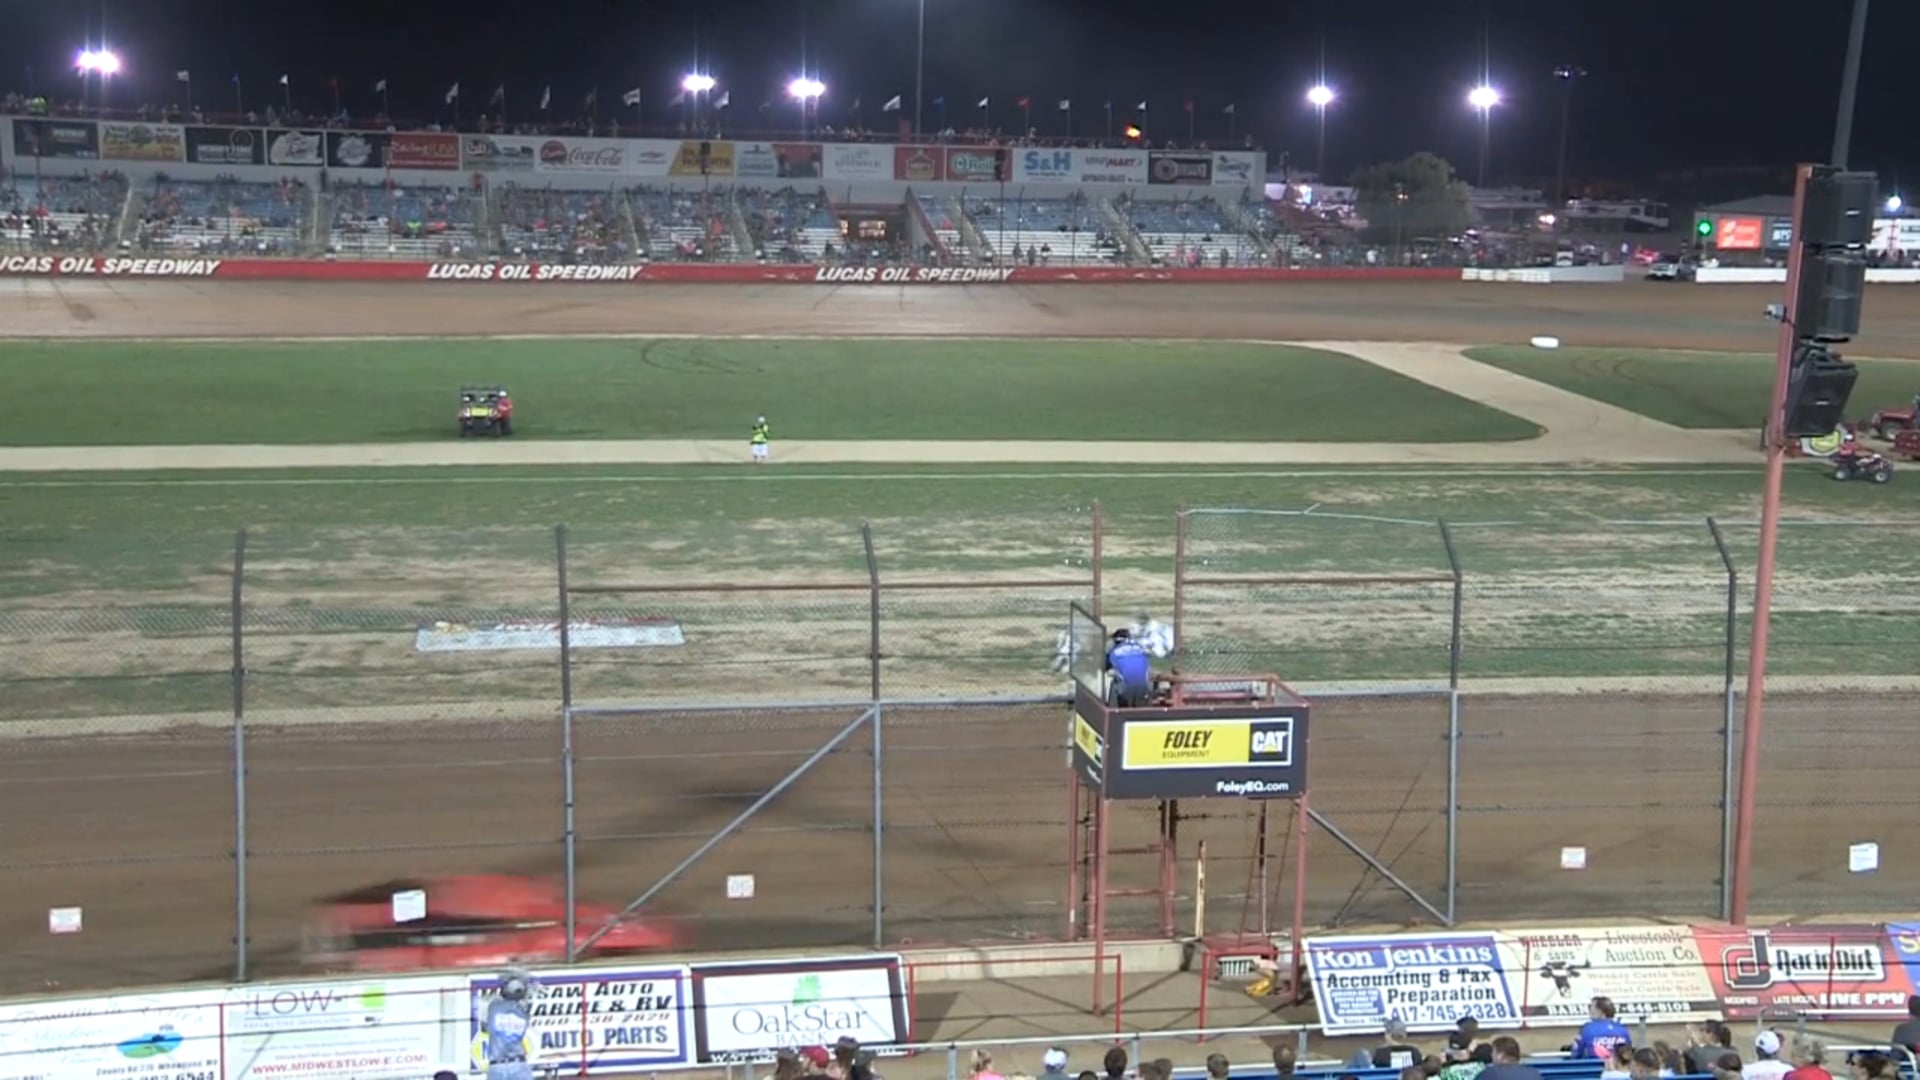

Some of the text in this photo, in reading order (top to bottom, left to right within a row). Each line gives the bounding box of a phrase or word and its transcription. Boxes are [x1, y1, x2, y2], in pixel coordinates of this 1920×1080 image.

[1025, 151, 1071, 171] S&H
[59, 257, 97, 273] OIL
[102, 258, 220, 276] SPEEDWAY
[427, 264, 642, 280] LUCAS OIL SPEEDWAY
[815, 266, 1014, 282] LUCAS OIL SPEEDWAY
[1163, 730, 1287, 753] FOLEY CAT
[1162, 750, 1210, 760] EQUIPMENT
[1216, 781, 1289, 796] FoleyEQ.com
[1517, 934, 1583, 948] WHEELER
[1381, 944, 1493, 973] Jenkins
[1605, 947, 1699, 963] Auction Co.
[1327, 968, 1492, 988] Accounting & Tax
[594, 982, 655, 997] AUTO
[1387, 987, 1498, 1005] Preparation
[636, 995, 674, 1011] RV
[1820, 993, 1860, 1005] LIVE
[1865, 992, 1906, 1005] PPV
[732, 1006, 867, 1036] OakStar
[541, 1025, 668, 1049] AUTO PARTS
[777, 1032, 829, 1048] BANK
